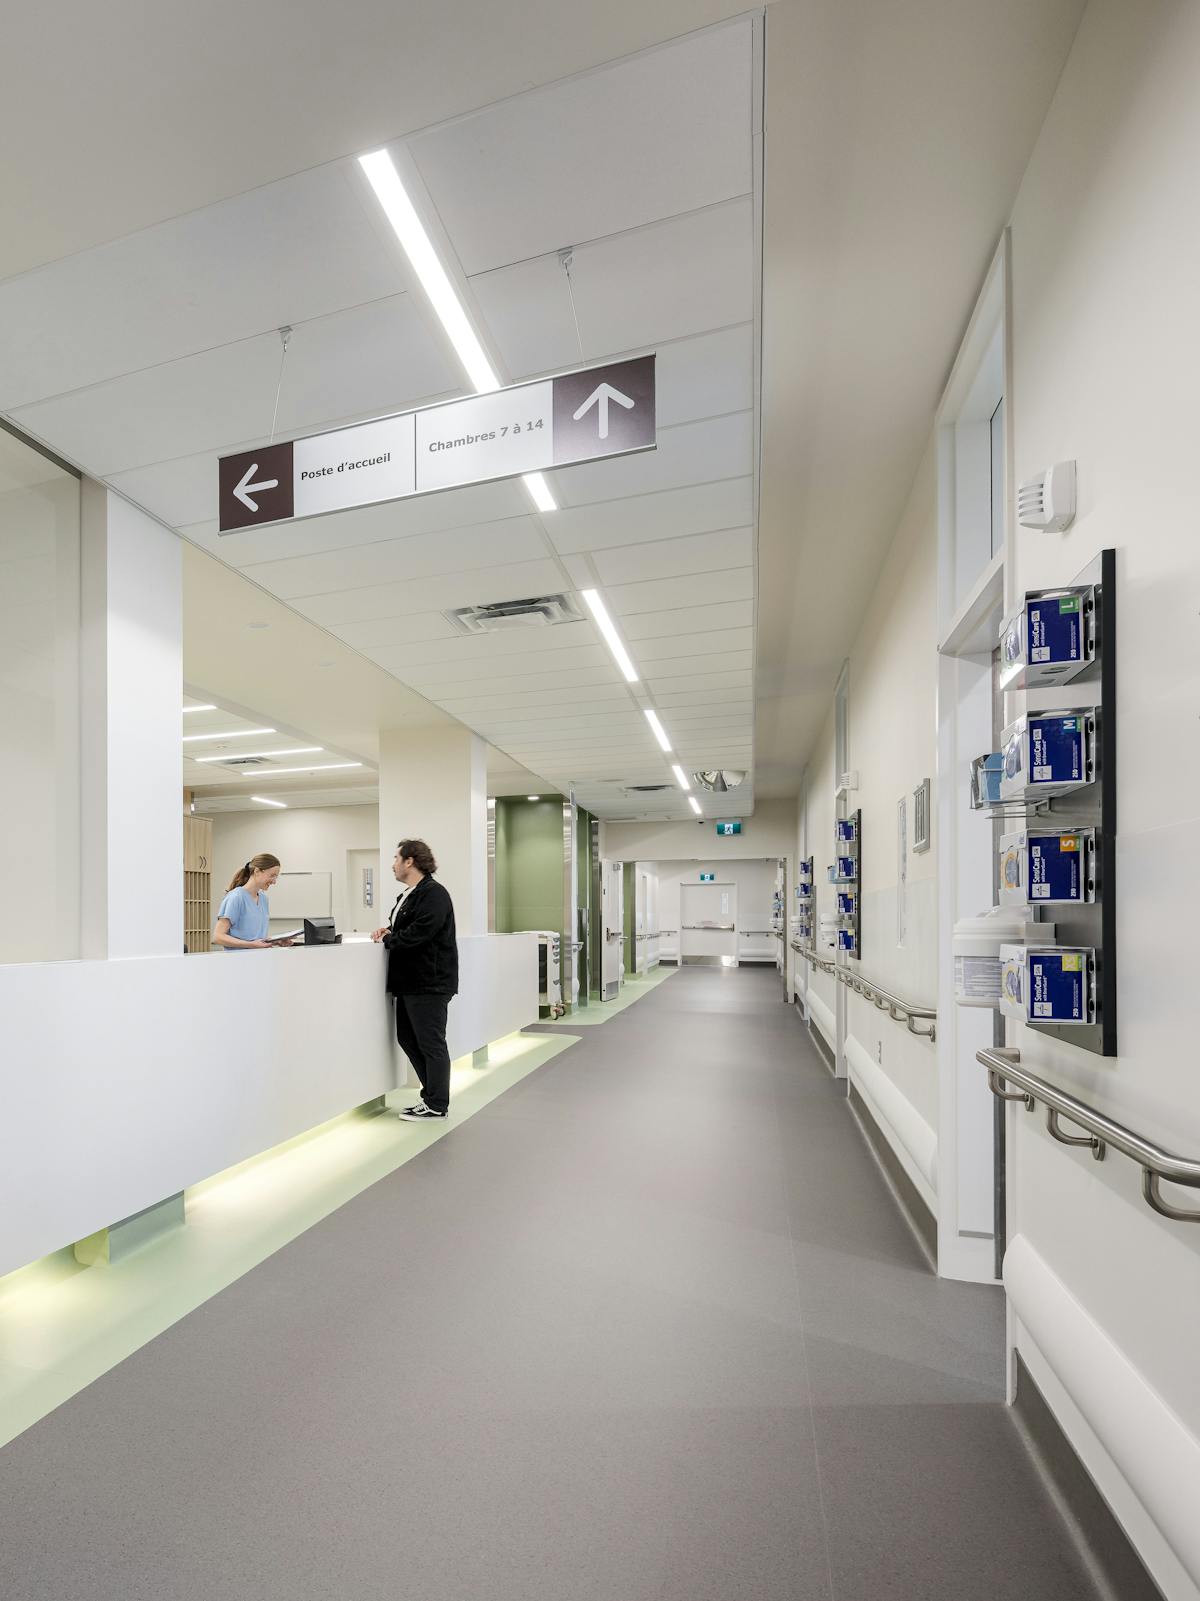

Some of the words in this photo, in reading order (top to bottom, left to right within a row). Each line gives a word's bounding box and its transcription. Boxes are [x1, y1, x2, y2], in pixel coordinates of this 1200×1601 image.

[429, 431, 496, 452] Chambres
[500, 426, 508, 437] 7
[513, 423, 521, 434] à
[527, 419, 544, 431] 14
[301, 467, 334, 480] Poste
[337, 452, 391, 472] d’accueil
[1061, 601, 1073, 609] L
[1032, 621, 1040, 647] SensiCare
[1063, 719, 1076, 730] M
[1033, 740, 1041, 766] SensiCare
[1062, 839, 1075, 848] S
[1032, 857, 1040, 883] SensiCare
[1065, 957, 1075, 969] XS
[1034, 976, 1042, 1001] SensiCare
